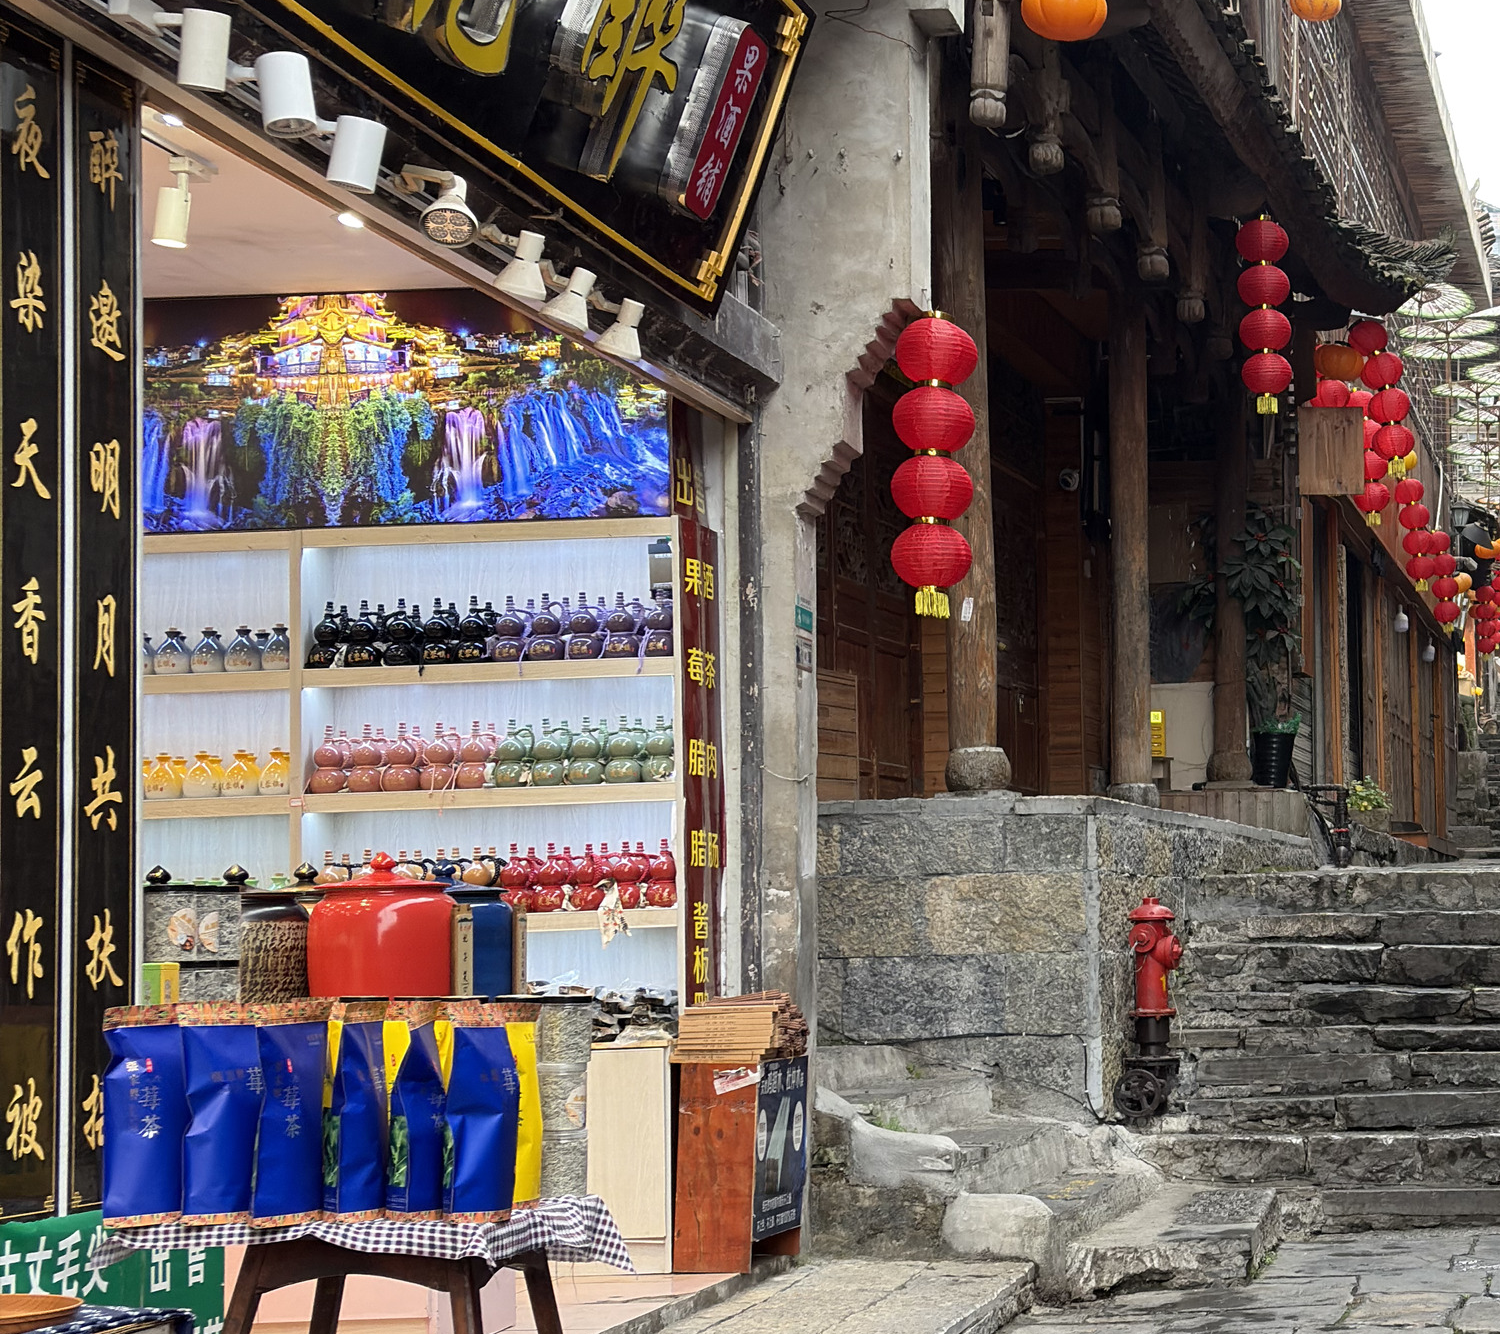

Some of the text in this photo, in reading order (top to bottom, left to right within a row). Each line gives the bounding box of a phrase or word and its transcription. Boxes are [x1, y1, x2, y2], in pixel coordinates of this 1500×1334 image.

[684, 557, 715, 602] 果酒
[6, 83, 51, 1161] 夜染天香云作被
[687, 646, 716, 690] 莓茶
[688, 738, 718, 779] 腊肉
[690, 829, 720, 869] 腊肠
[692, 901, 709, 1005] 酱板
